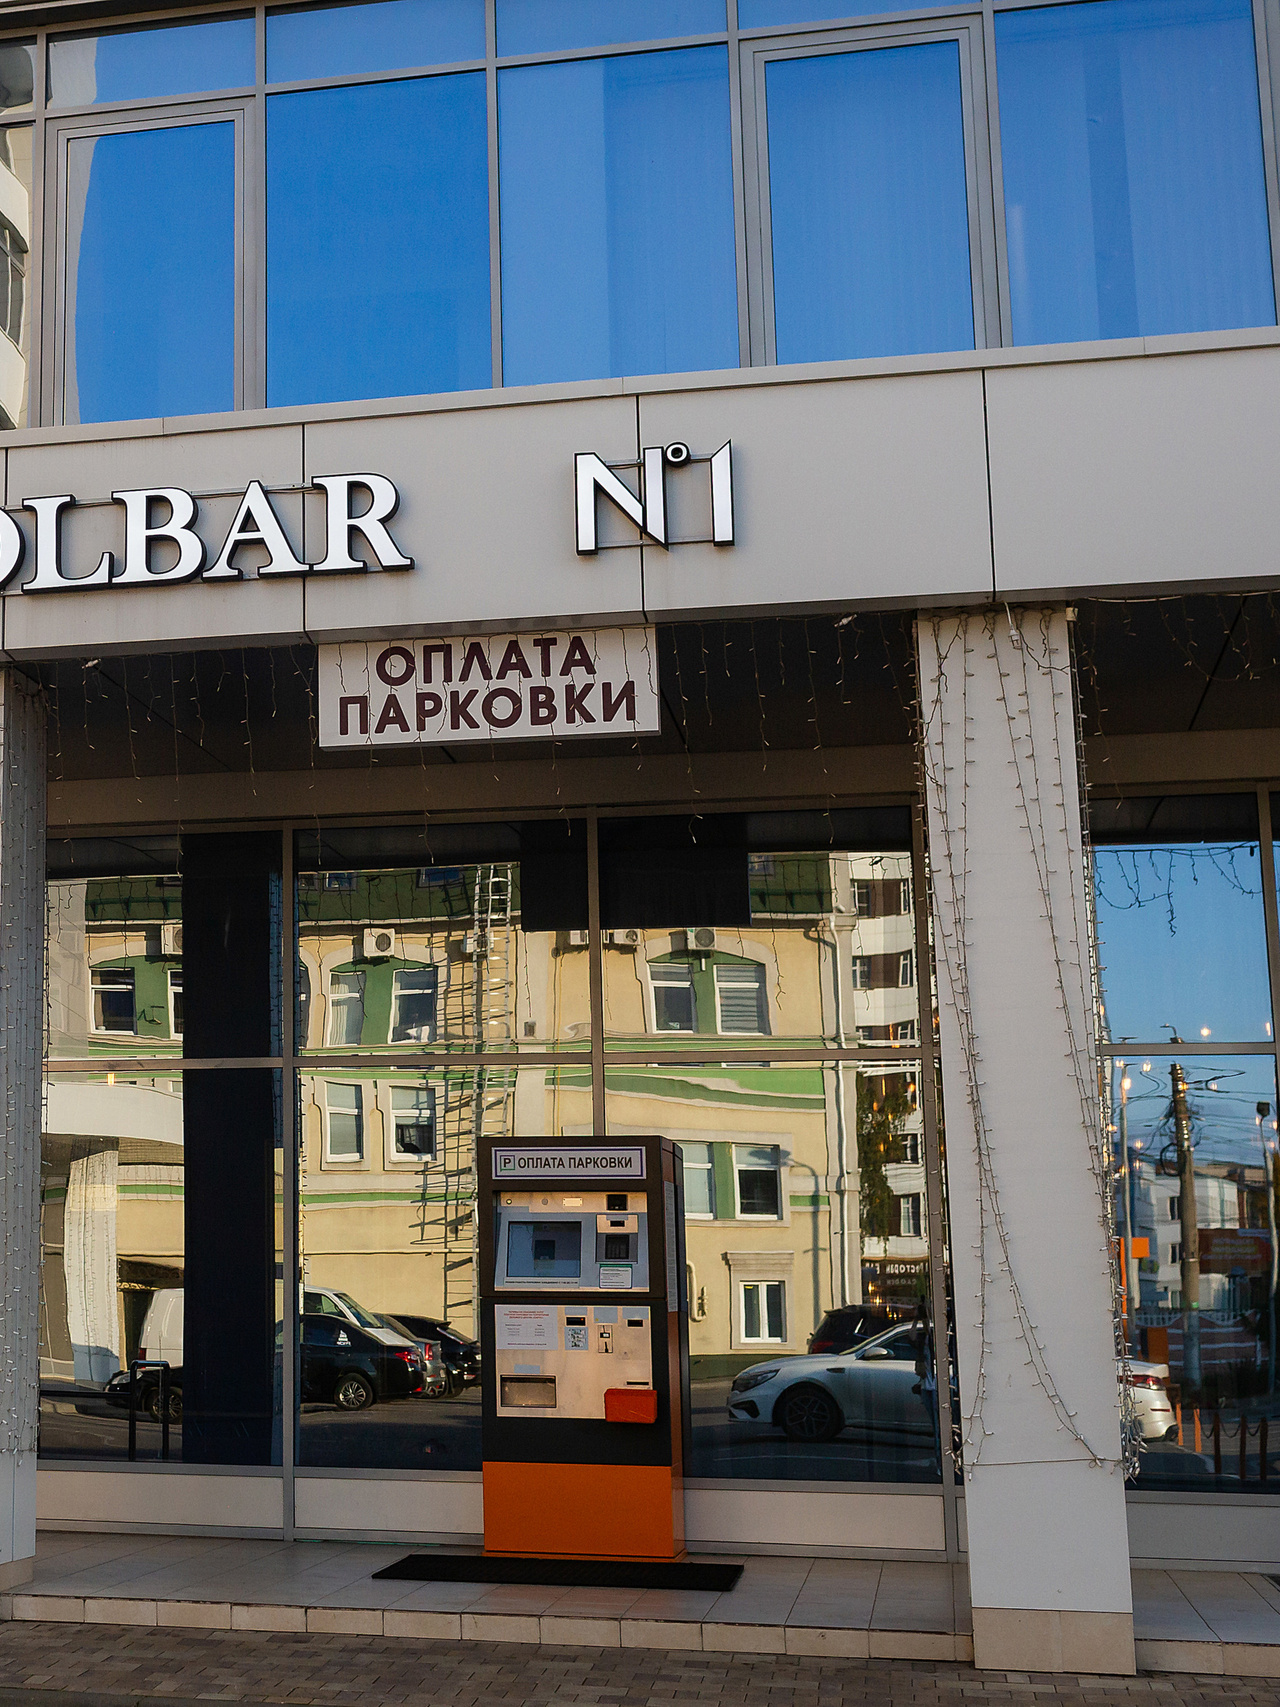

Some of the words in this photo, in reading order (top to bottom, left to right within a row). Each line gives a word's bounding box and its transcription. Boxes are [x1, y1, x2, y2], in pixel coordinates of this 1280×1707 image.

[375, 636, 596, 688] ОПЛАТА
[338, 679, 637, 737] ПАРКОВКИ
[517, 1156, 566, 1169] ОПЛАТА
[568, 1156, 633, 1169] ПАРКОВКИ
